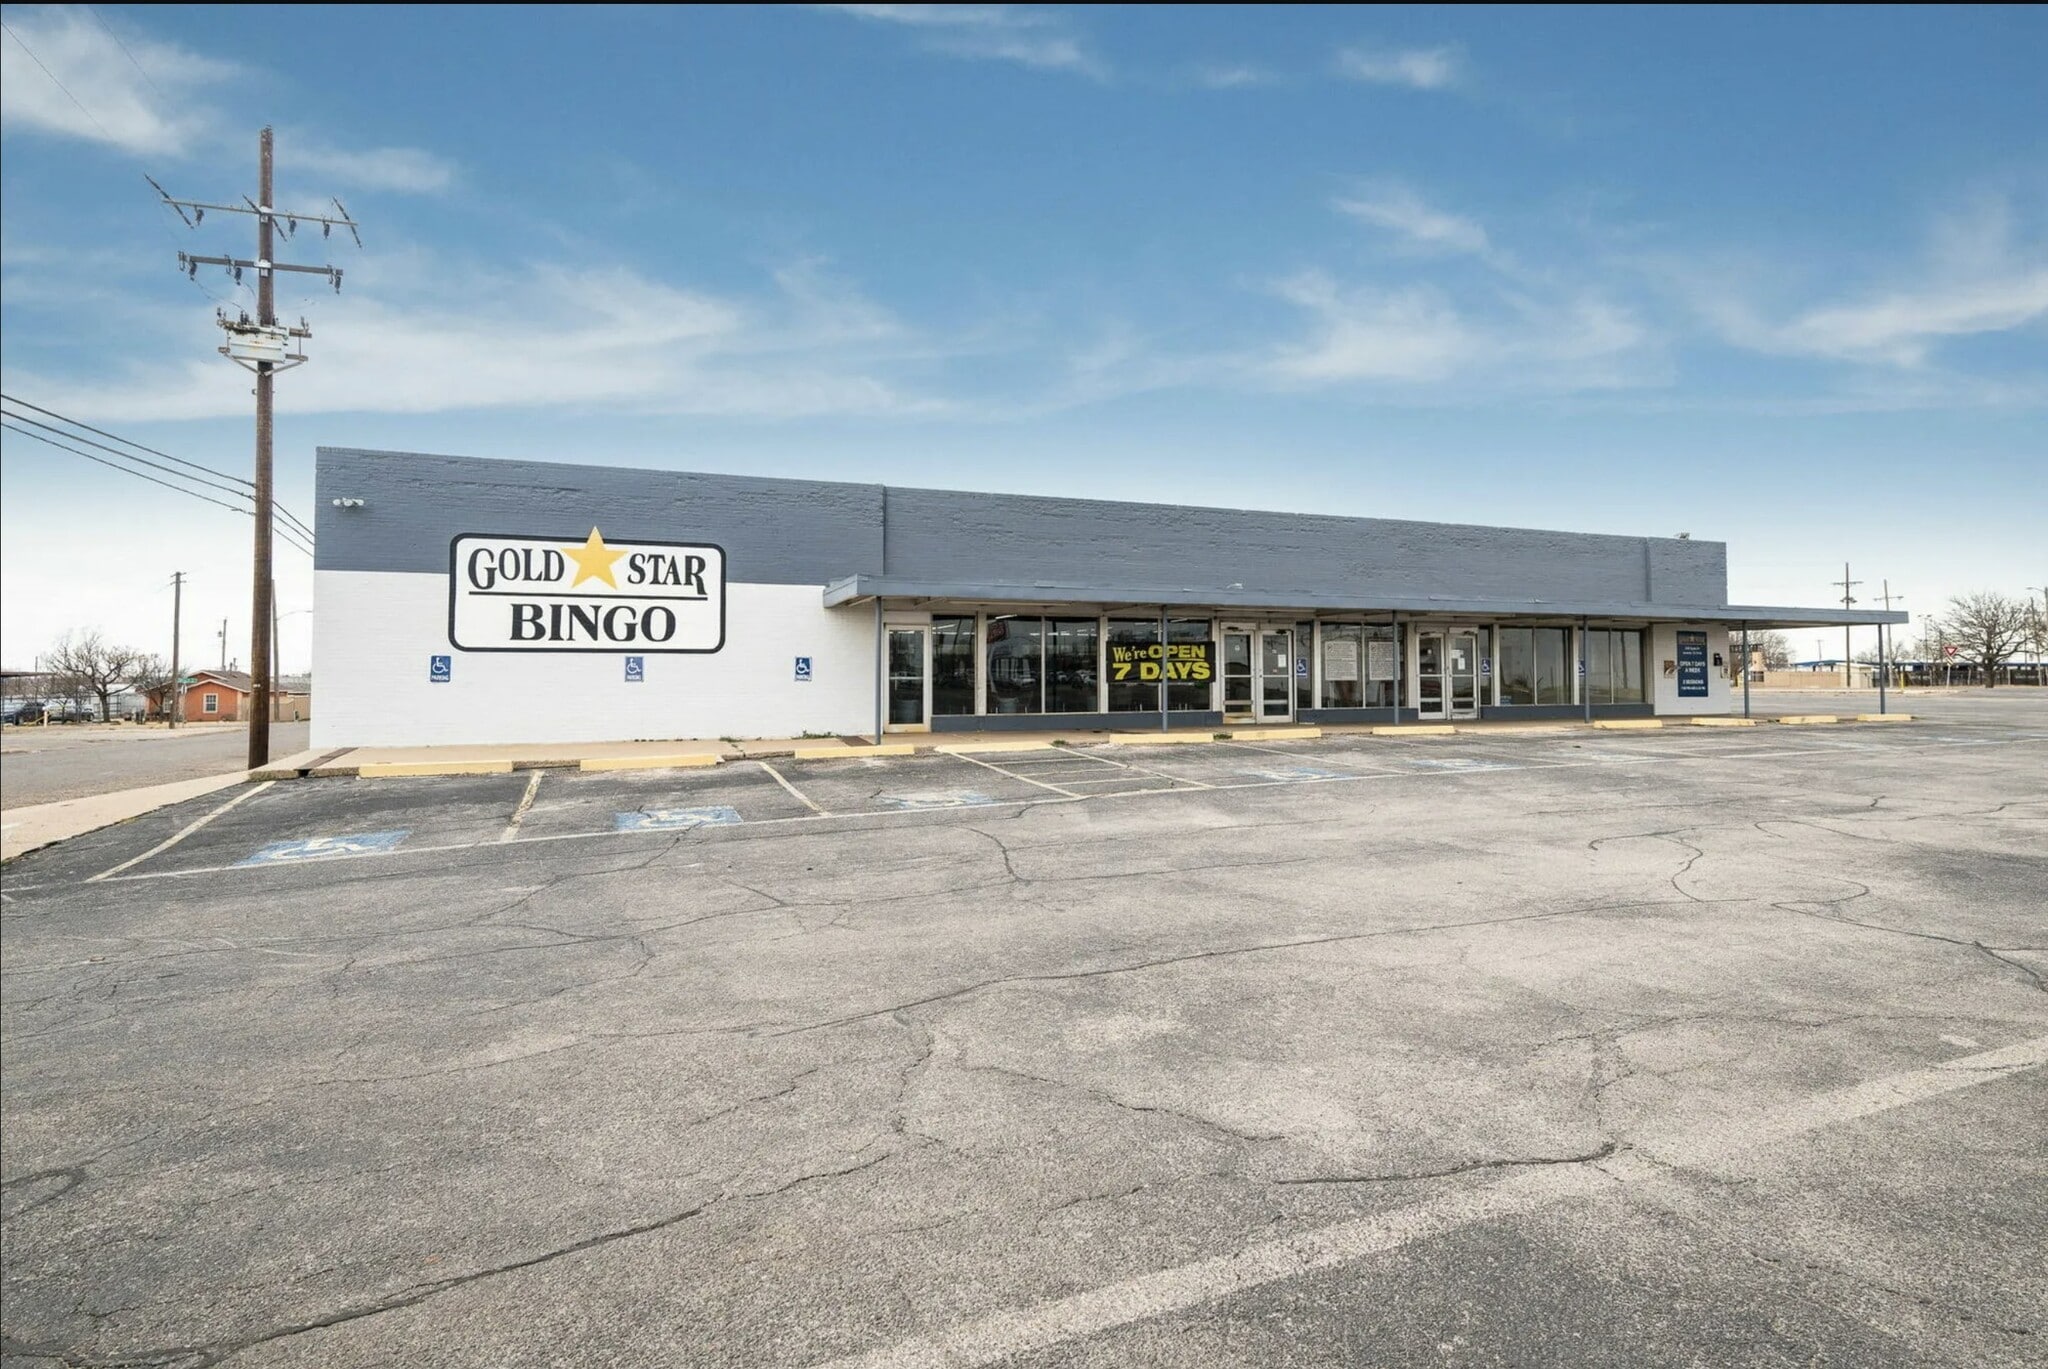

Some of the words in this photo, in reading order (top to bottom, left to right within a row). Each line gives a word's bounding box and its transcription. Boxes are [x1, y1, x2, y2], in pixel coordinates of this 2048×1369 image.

[468, 547, 565, 590] GOLD
[627, 553, 707, 595] STAR
[510, 603, 676, 642] BINGO
[1112, 645, 1147, 662] We're
[1148, 644, 1206, 659] OPEN
[1112, 662, 1132, 680] 7
[1140, 662, 1211, 680] DAYS
